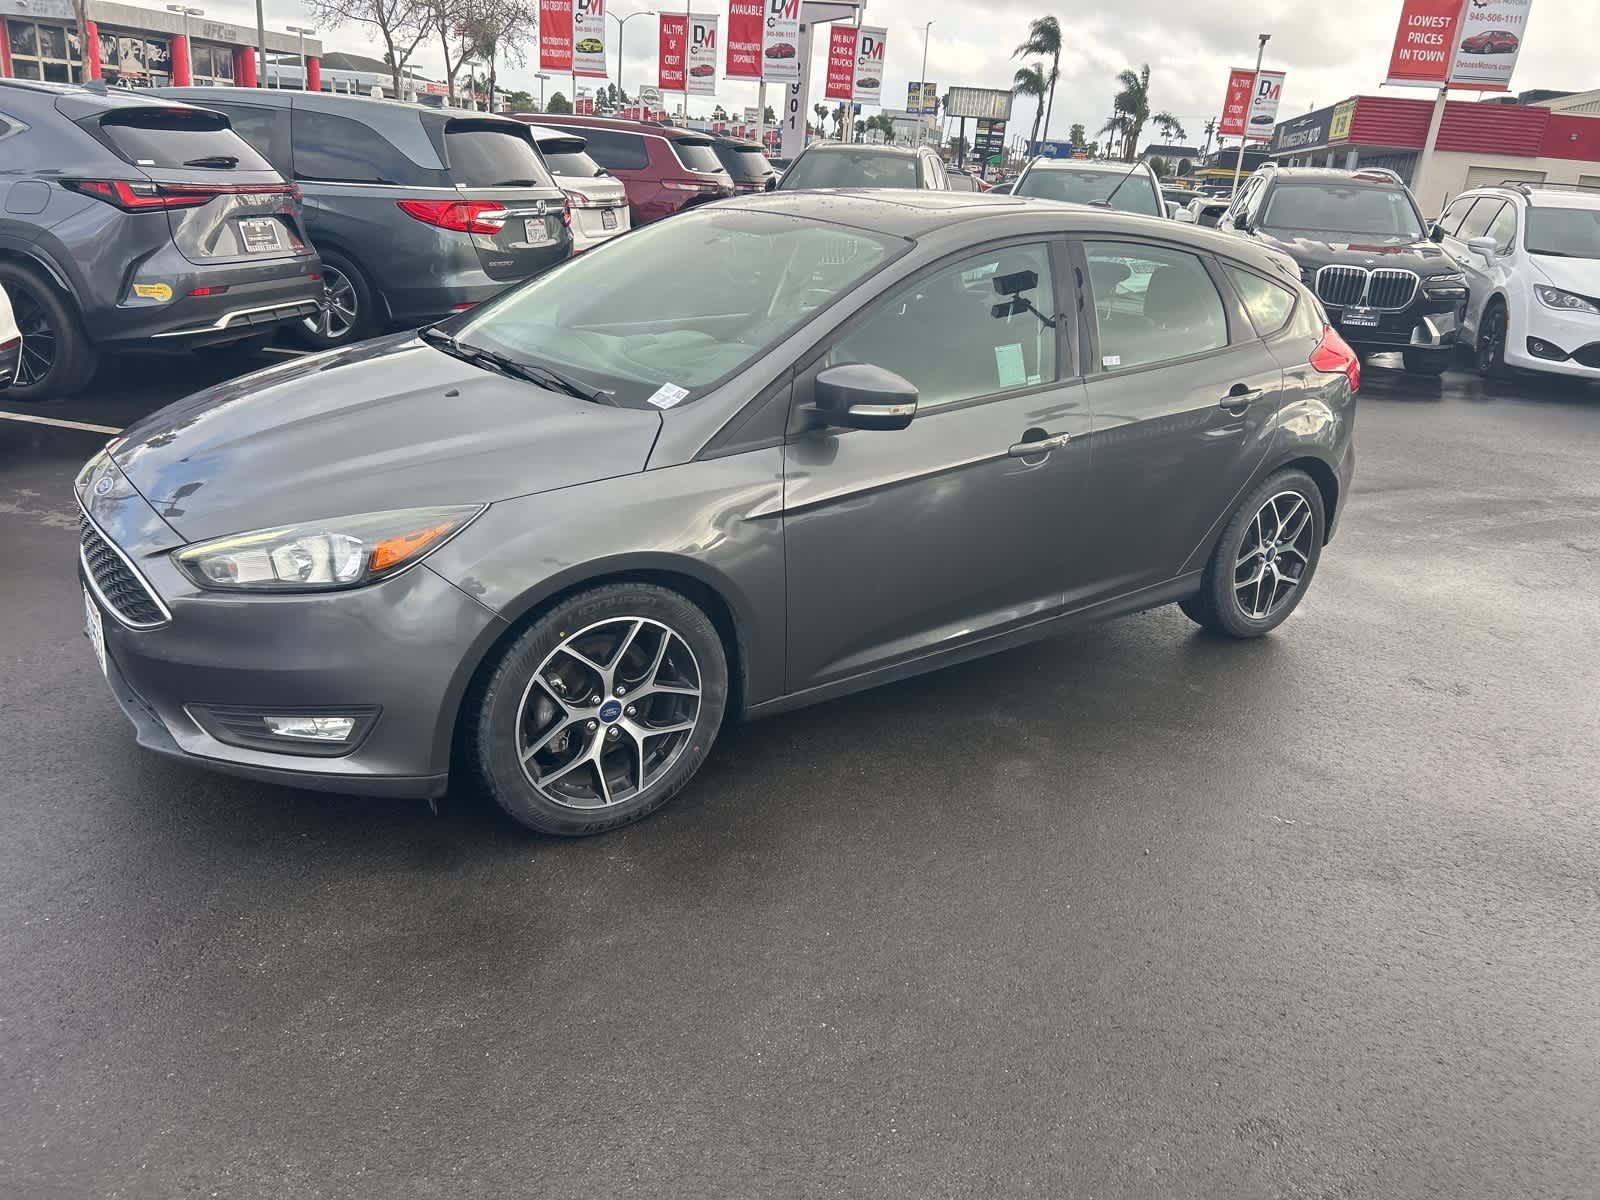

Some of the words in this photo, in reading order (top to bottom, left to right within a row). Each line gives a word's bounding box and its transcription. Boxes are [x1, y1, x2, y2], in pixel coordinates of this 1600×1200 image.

[731, 4, 763, 16] AVAILABLE
[1408, 15, 1452, 28] LOWEST
[1470, 12, 1522, 24] 949-506-1111
[663, 24, 672, 34] ALL
[672, 25, 684, 35] TYPE
[832, 34, 842, 43] WE
[843, 35, 855, 44] BUY
[1407, 31, 1444, 45] PRICES
[669, 40, 676, 49] OF
[832, 46, 847, 55] CARS
[1400, 48, 1411, 60] IN
[1413, 50, 1445, 62] TOWN
[664, 55, 680, 65] CREDIT
[831, 57, 853, 67] TRUCKS
[661, 70, 683, 80] WELCOME
[789, 63, 800, 130] 901
